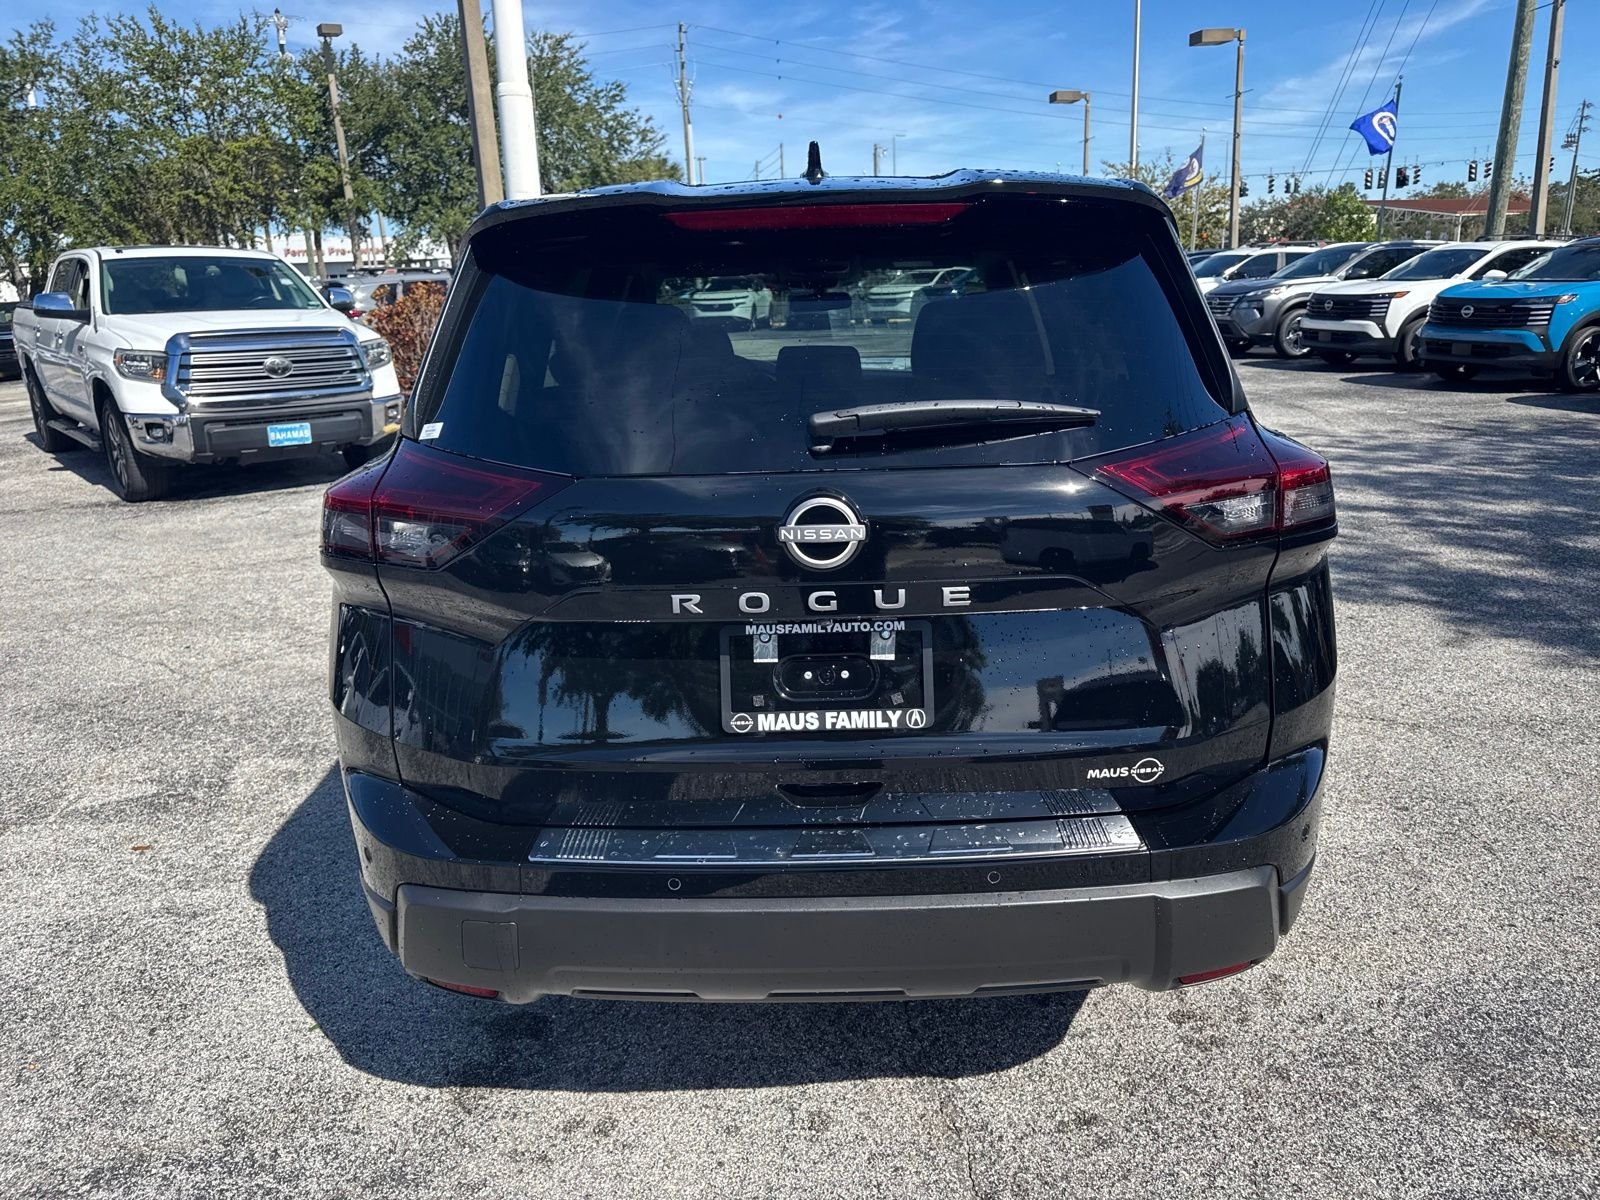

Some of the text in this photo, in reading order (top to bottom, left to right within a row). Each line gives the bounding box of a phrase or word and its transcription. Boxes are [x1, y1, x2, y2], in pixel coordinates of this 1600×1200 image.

[284, 248, 324, 257] Fer
[270, 430, 309, 440] BAHAMAS
[781, 528, 864, 540] NISSAN
[671, 586, 972, 614] ROGUE
[745, 621, 906, 635] MAUSFAMILYAUTO.COM
[757, 712, 820, 731] MAUS
[825, 710, 903, 729] FAMILY
[1087, 766, 1165, 779] MAUS NISSAN
